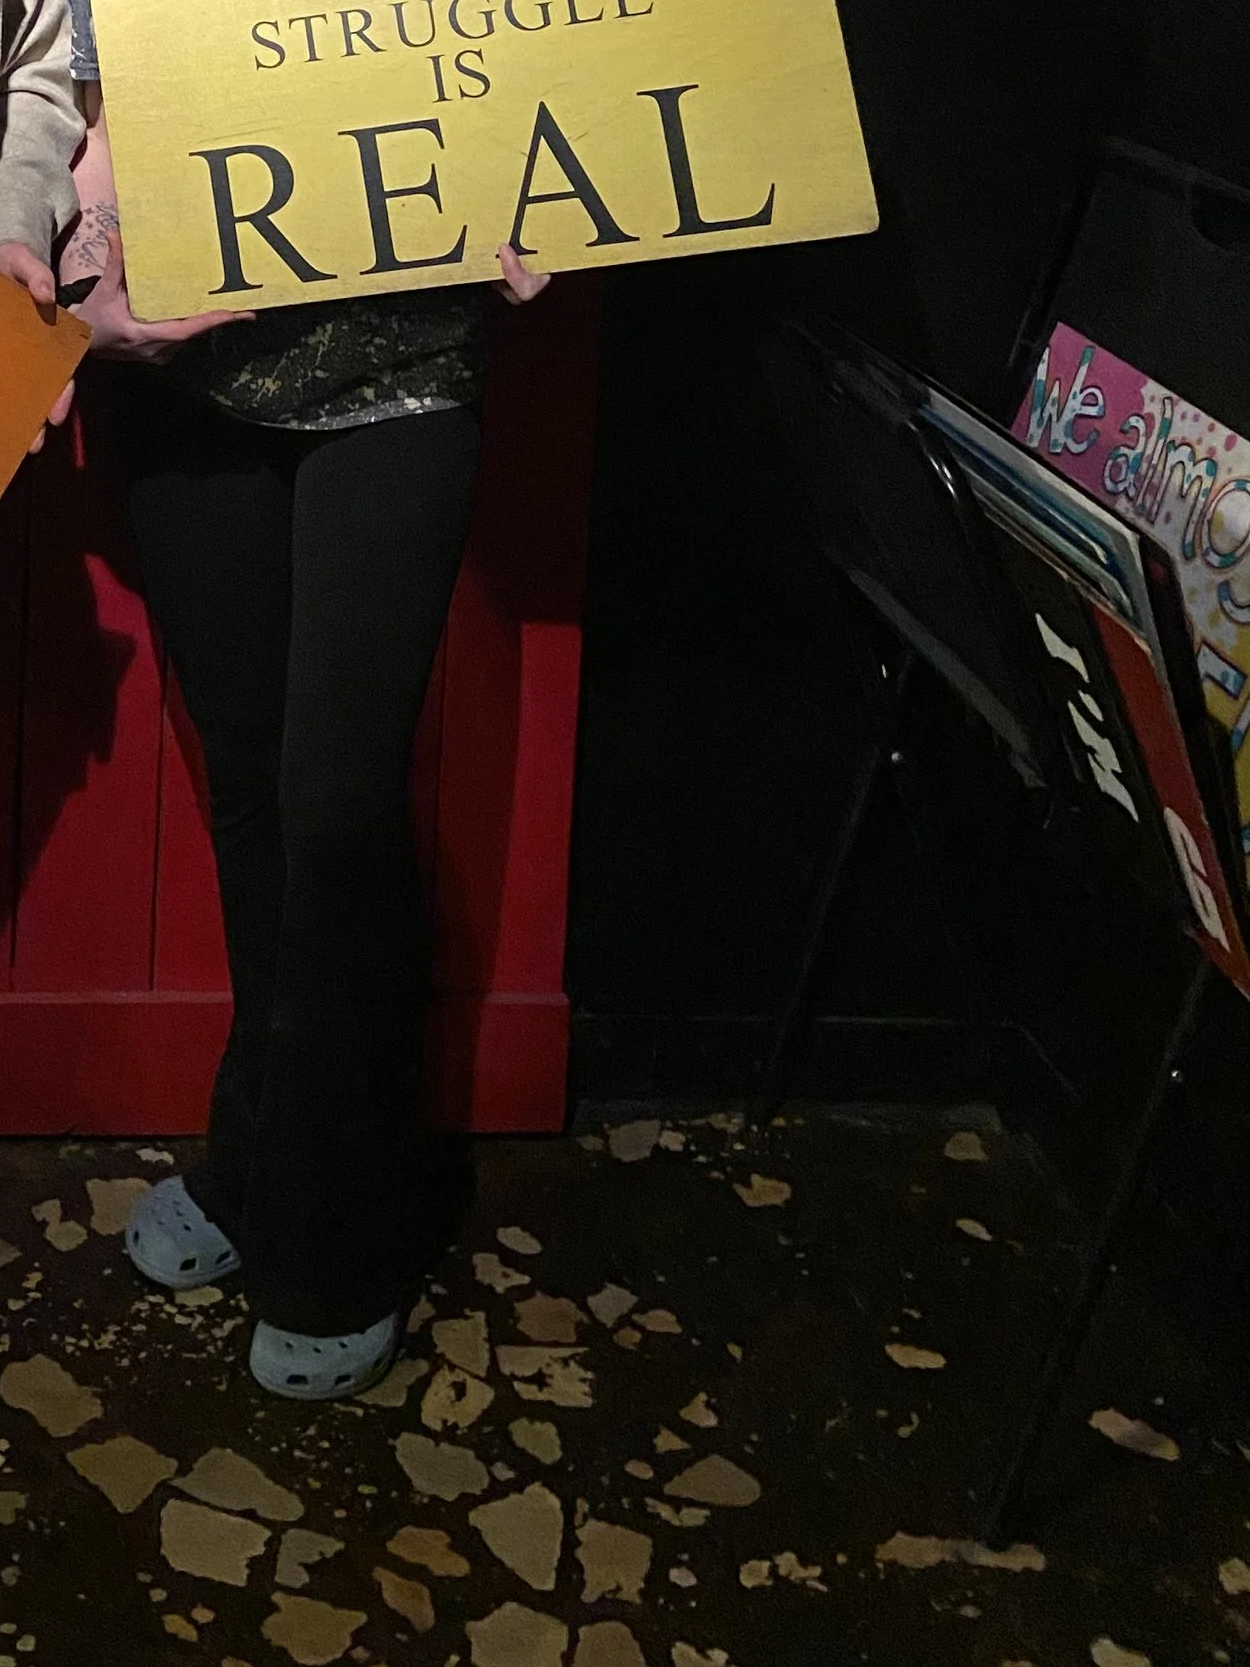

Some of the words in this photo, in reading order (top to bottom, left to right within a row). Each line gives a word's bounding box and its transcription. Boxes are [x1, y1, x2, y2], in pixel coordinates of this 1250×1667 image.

[428, 48, 492, 103] IS
[188, 83, 776, 296] REAL
[1025, 345, 1105, 454] We
